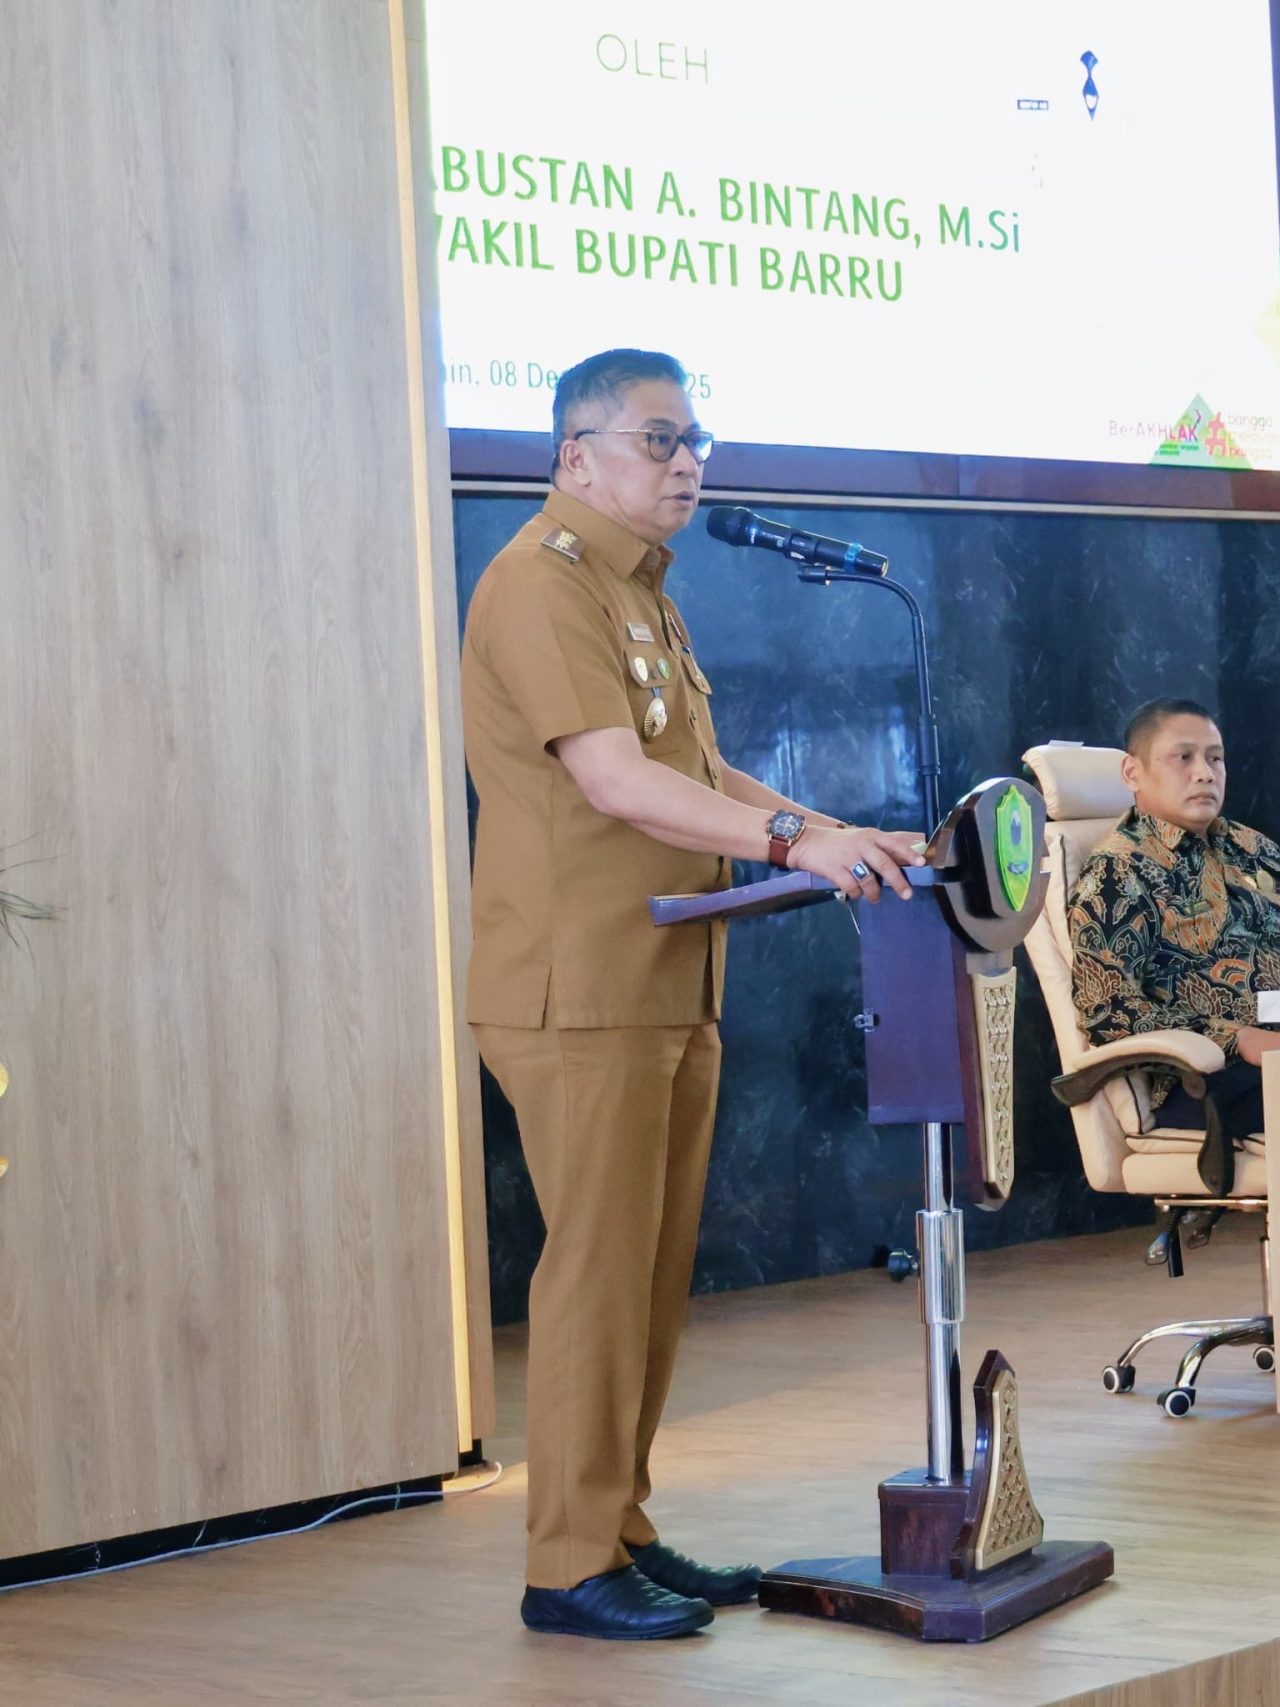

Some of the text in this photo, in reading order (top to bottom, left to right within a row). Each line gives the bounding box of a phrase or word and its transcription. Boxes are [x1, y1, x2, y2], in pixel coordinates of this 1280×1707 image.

[596, 33, 709, 84] OLEH
[433, 145, 1020, 254] BUSTAN A. BINTANG, M.Si
[575, 229, 739, 288] BUPATI
[759, 247, 903, 303] BARRU
[443, 355, 480, 387] in,
[489, 359, 518, 388] 08
[687, 373, 711, 399] 25
